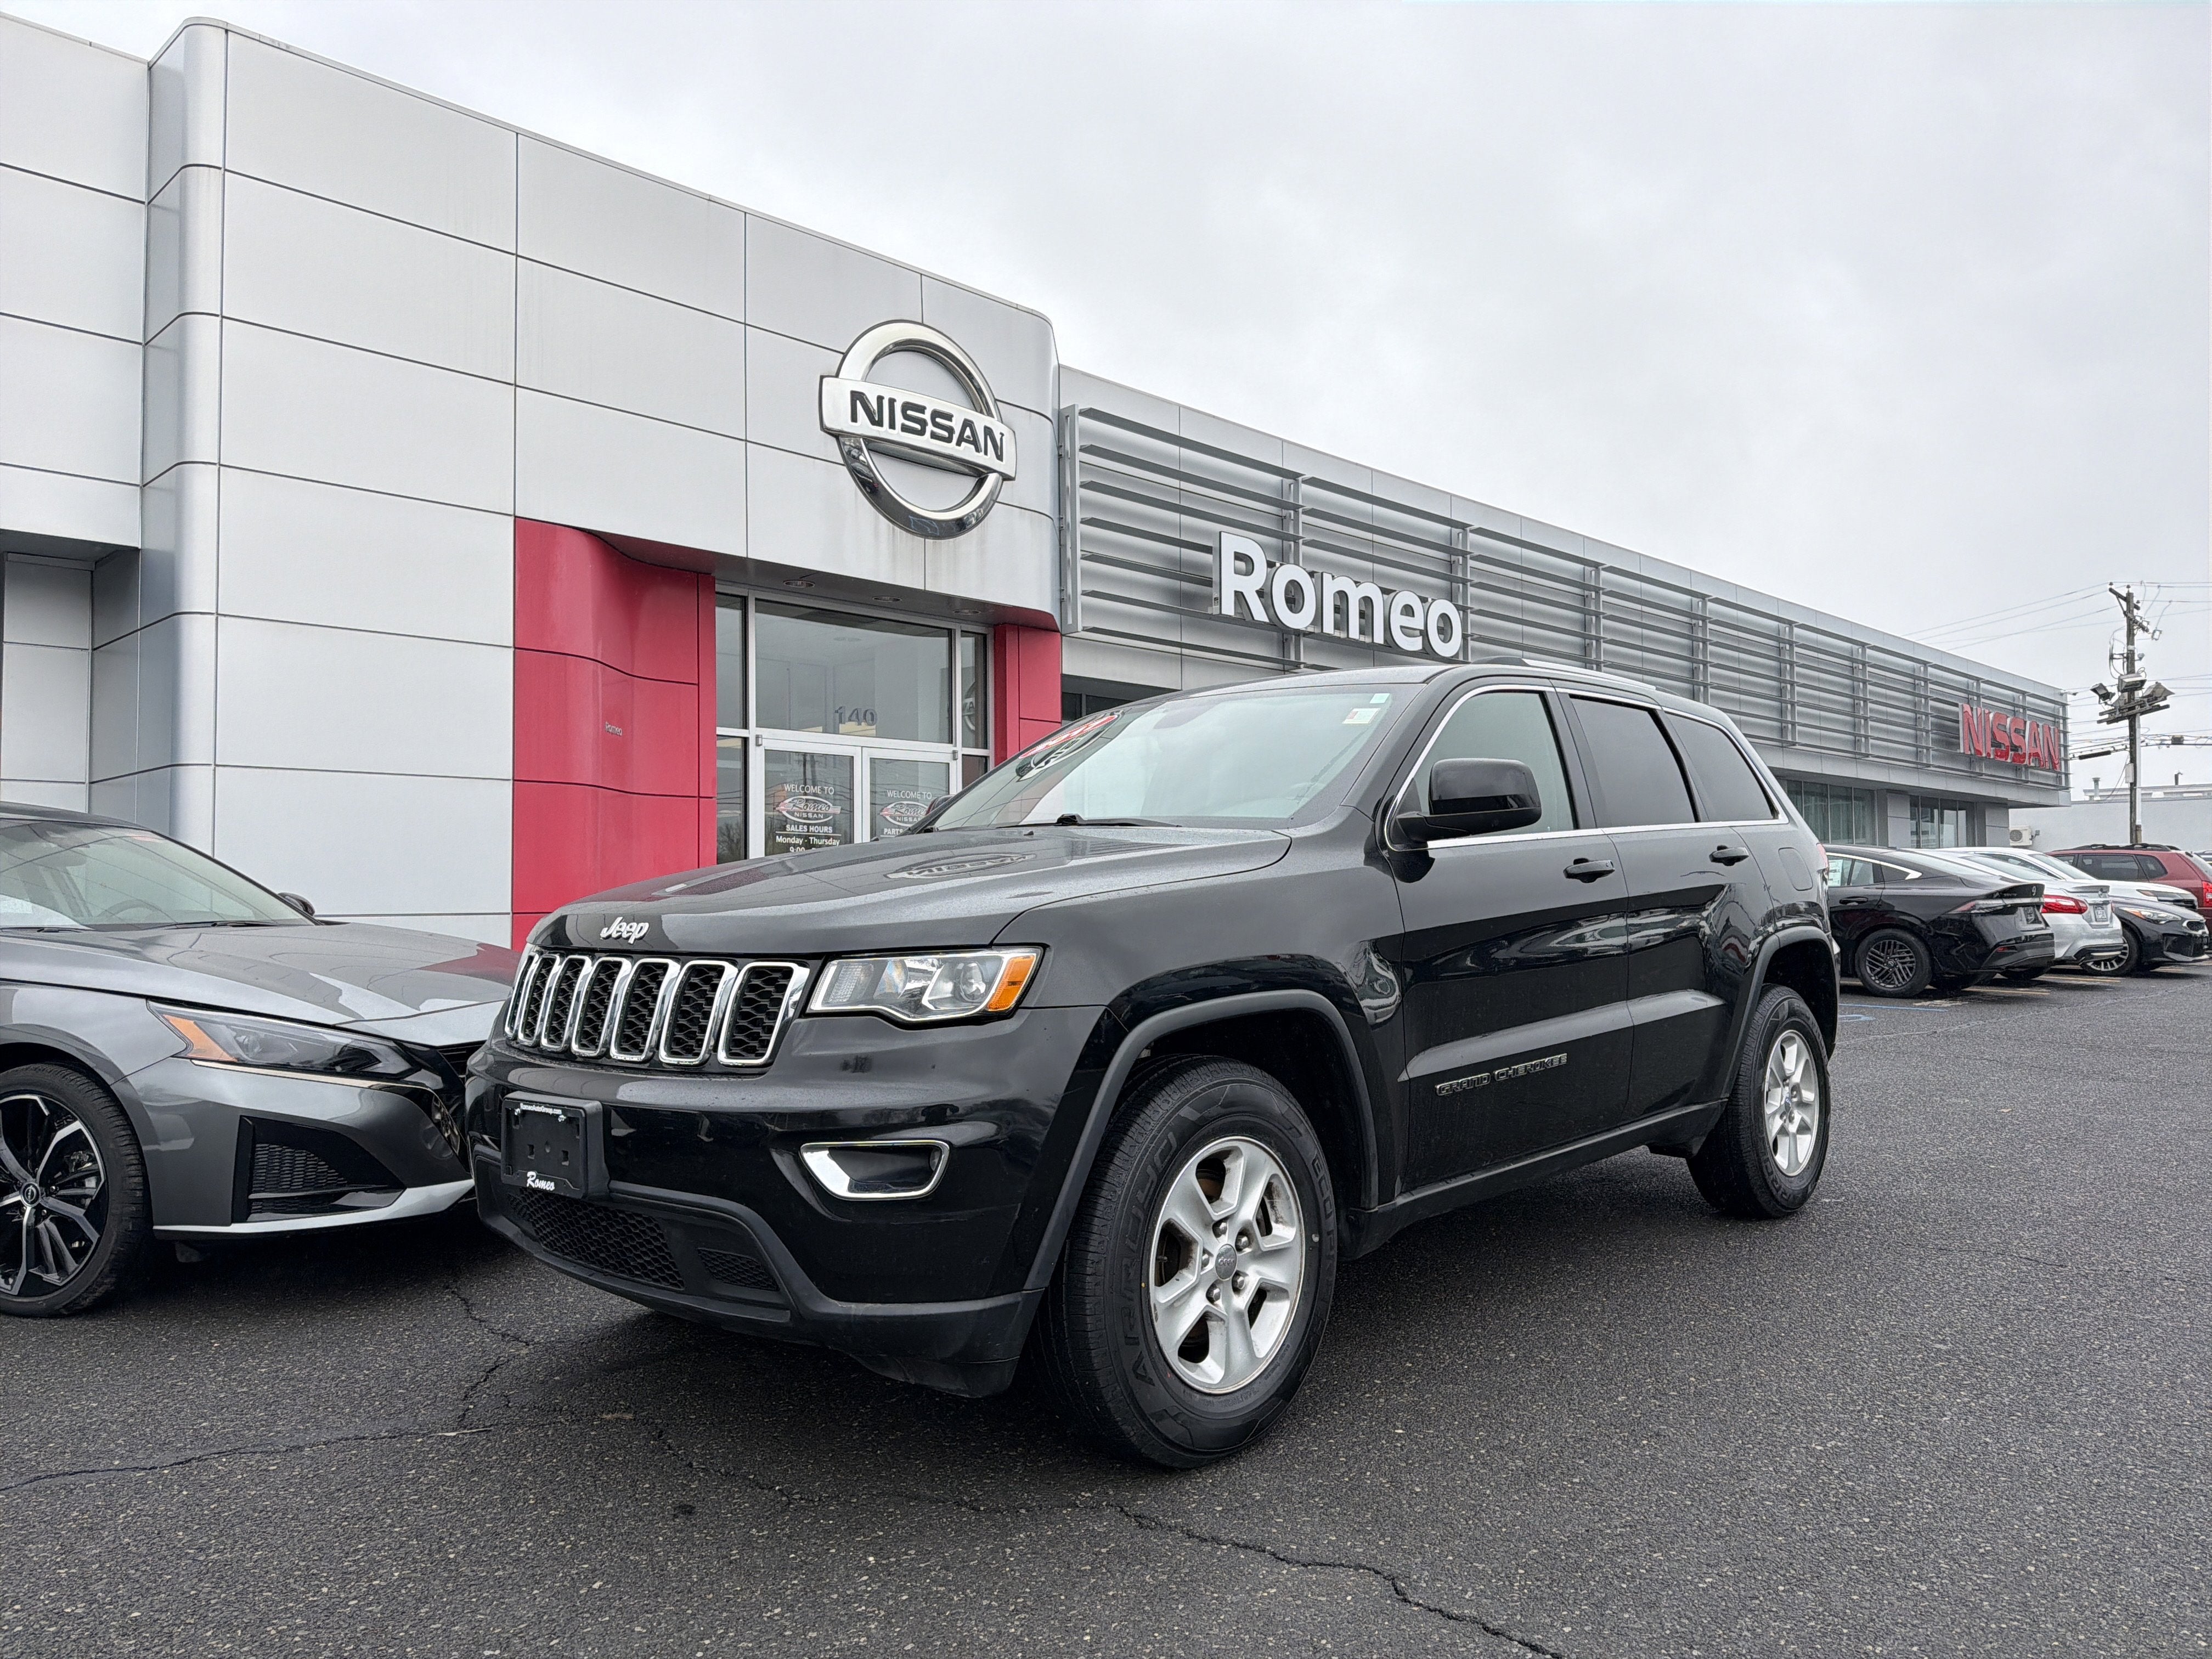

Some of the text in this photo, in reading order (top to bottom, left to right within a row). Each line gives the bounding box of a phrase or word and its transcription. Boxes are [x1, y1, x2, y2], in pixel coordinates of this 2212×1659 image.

[850, 390, 1005, 462] NISSAN
[1219, 531, 1462, 658] Romeo
[834, 706, 878, 726] 140
[605, 721, 623, 736] Romeo
[1961, 703, 2061, 771] NISSAN
[785, 784, 834, 795] WELCOME TO
[887, 790, 921, 799] WELCOME
[788, 798, 831, 812] Romeo
[891, 803, 927, 815] Rome
[776, 835, 803, 845] Monday
[809, 837, 840, 847] Thursday
[600, 916, 650, 944] Jeep
[1435, 1053, 1567, 1096] GRAND CHEROKEE
[527, 1171, 555, 1191] Romeo
